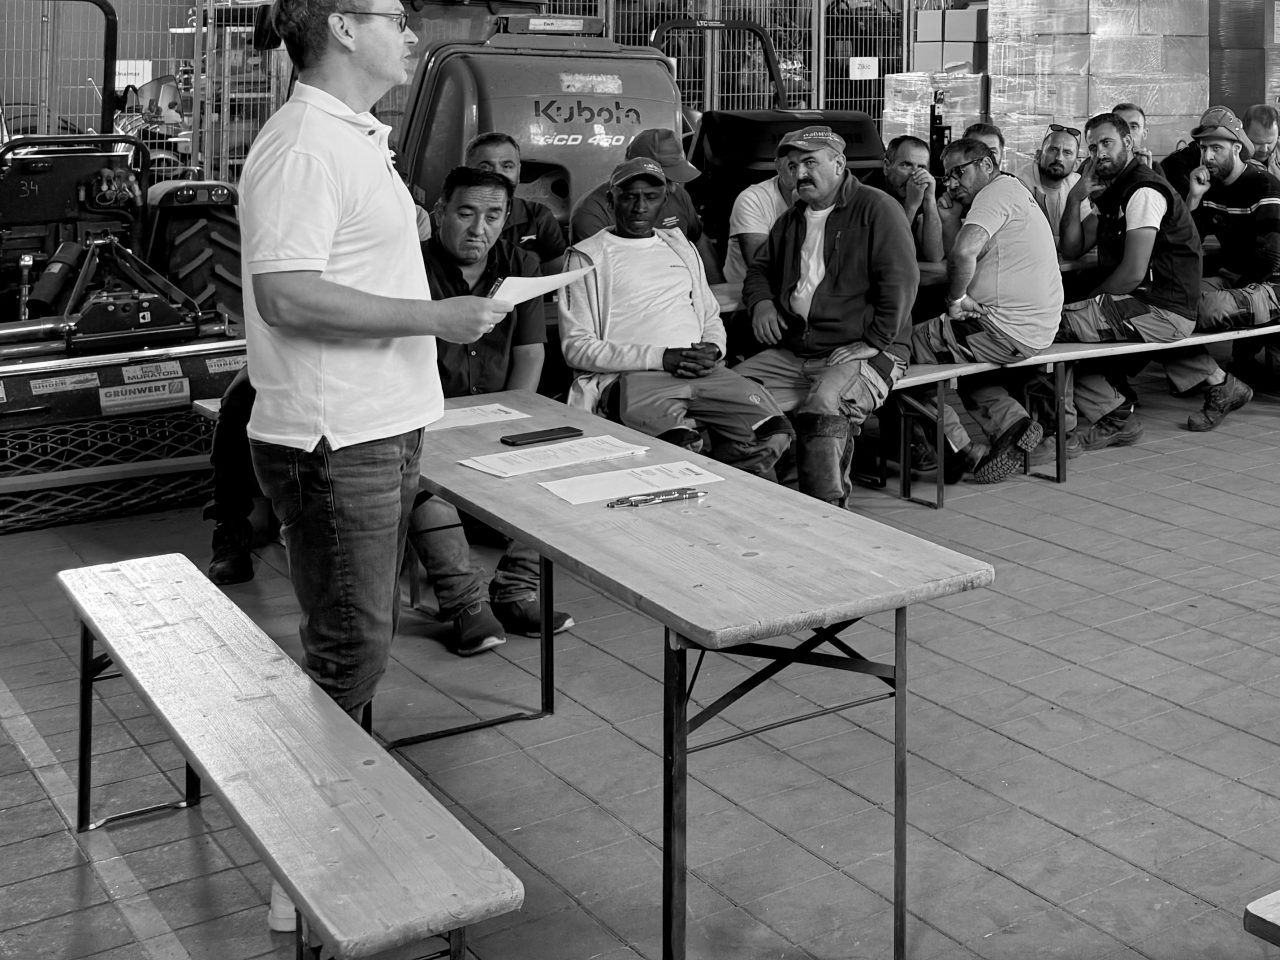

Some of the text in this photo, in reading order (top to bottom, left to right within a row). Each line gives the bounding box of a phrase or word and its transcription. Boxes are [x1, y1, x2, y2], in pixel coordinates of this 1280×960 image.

[19, 180, 38, 198] 34
[126, 369, 179, 381] MURATORI
[104, 384, 167, 399] GRÜNWERT
